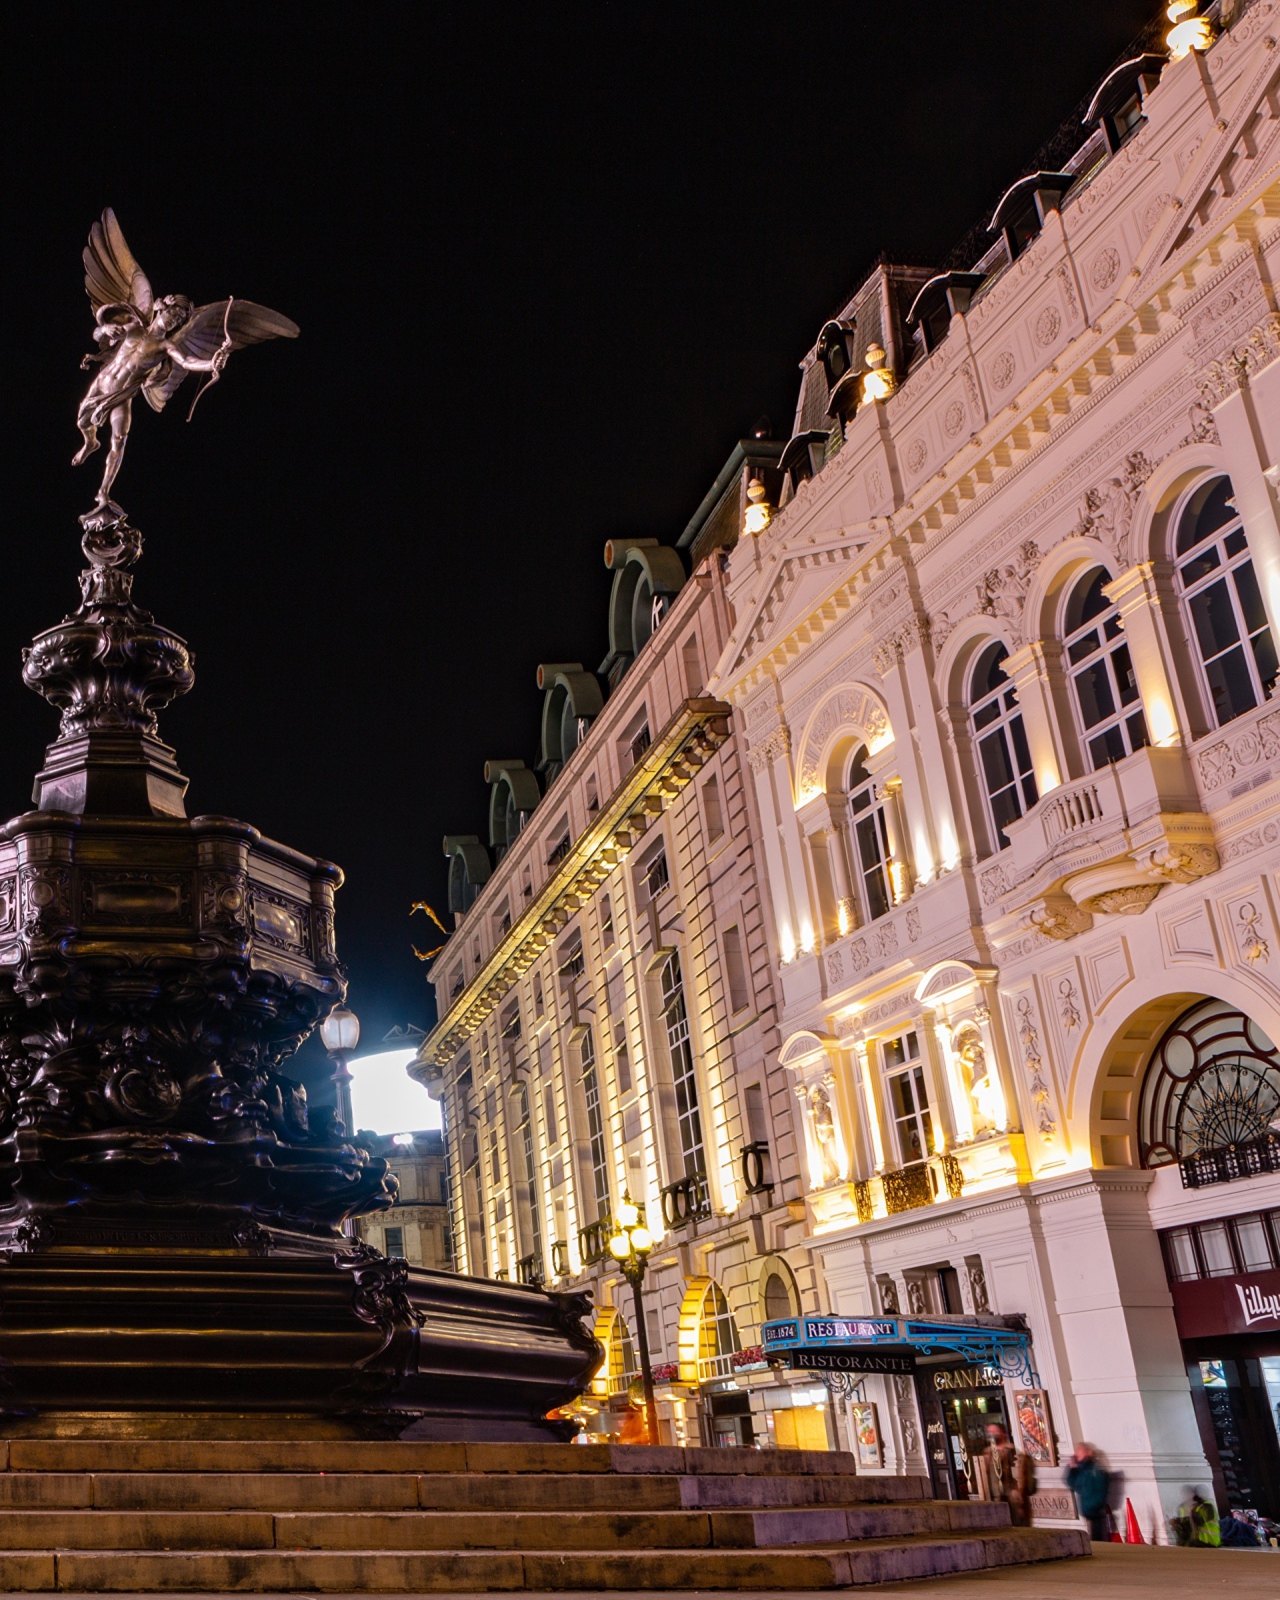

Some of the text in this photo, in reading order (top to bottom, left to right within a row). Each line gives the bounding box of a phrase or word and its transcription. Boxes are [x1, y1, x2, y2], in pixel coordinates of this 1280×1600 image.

[1235, 1284, 1280, 1327] Lilly
[807, 1322, 893, 1338] RESTAURANT
[798, 1354, 912, 1371] RISTORANTE
[933, 1367, 1001, 1390] GRANAIO
[1030, 1496, 1069, 1511] RANAIO
